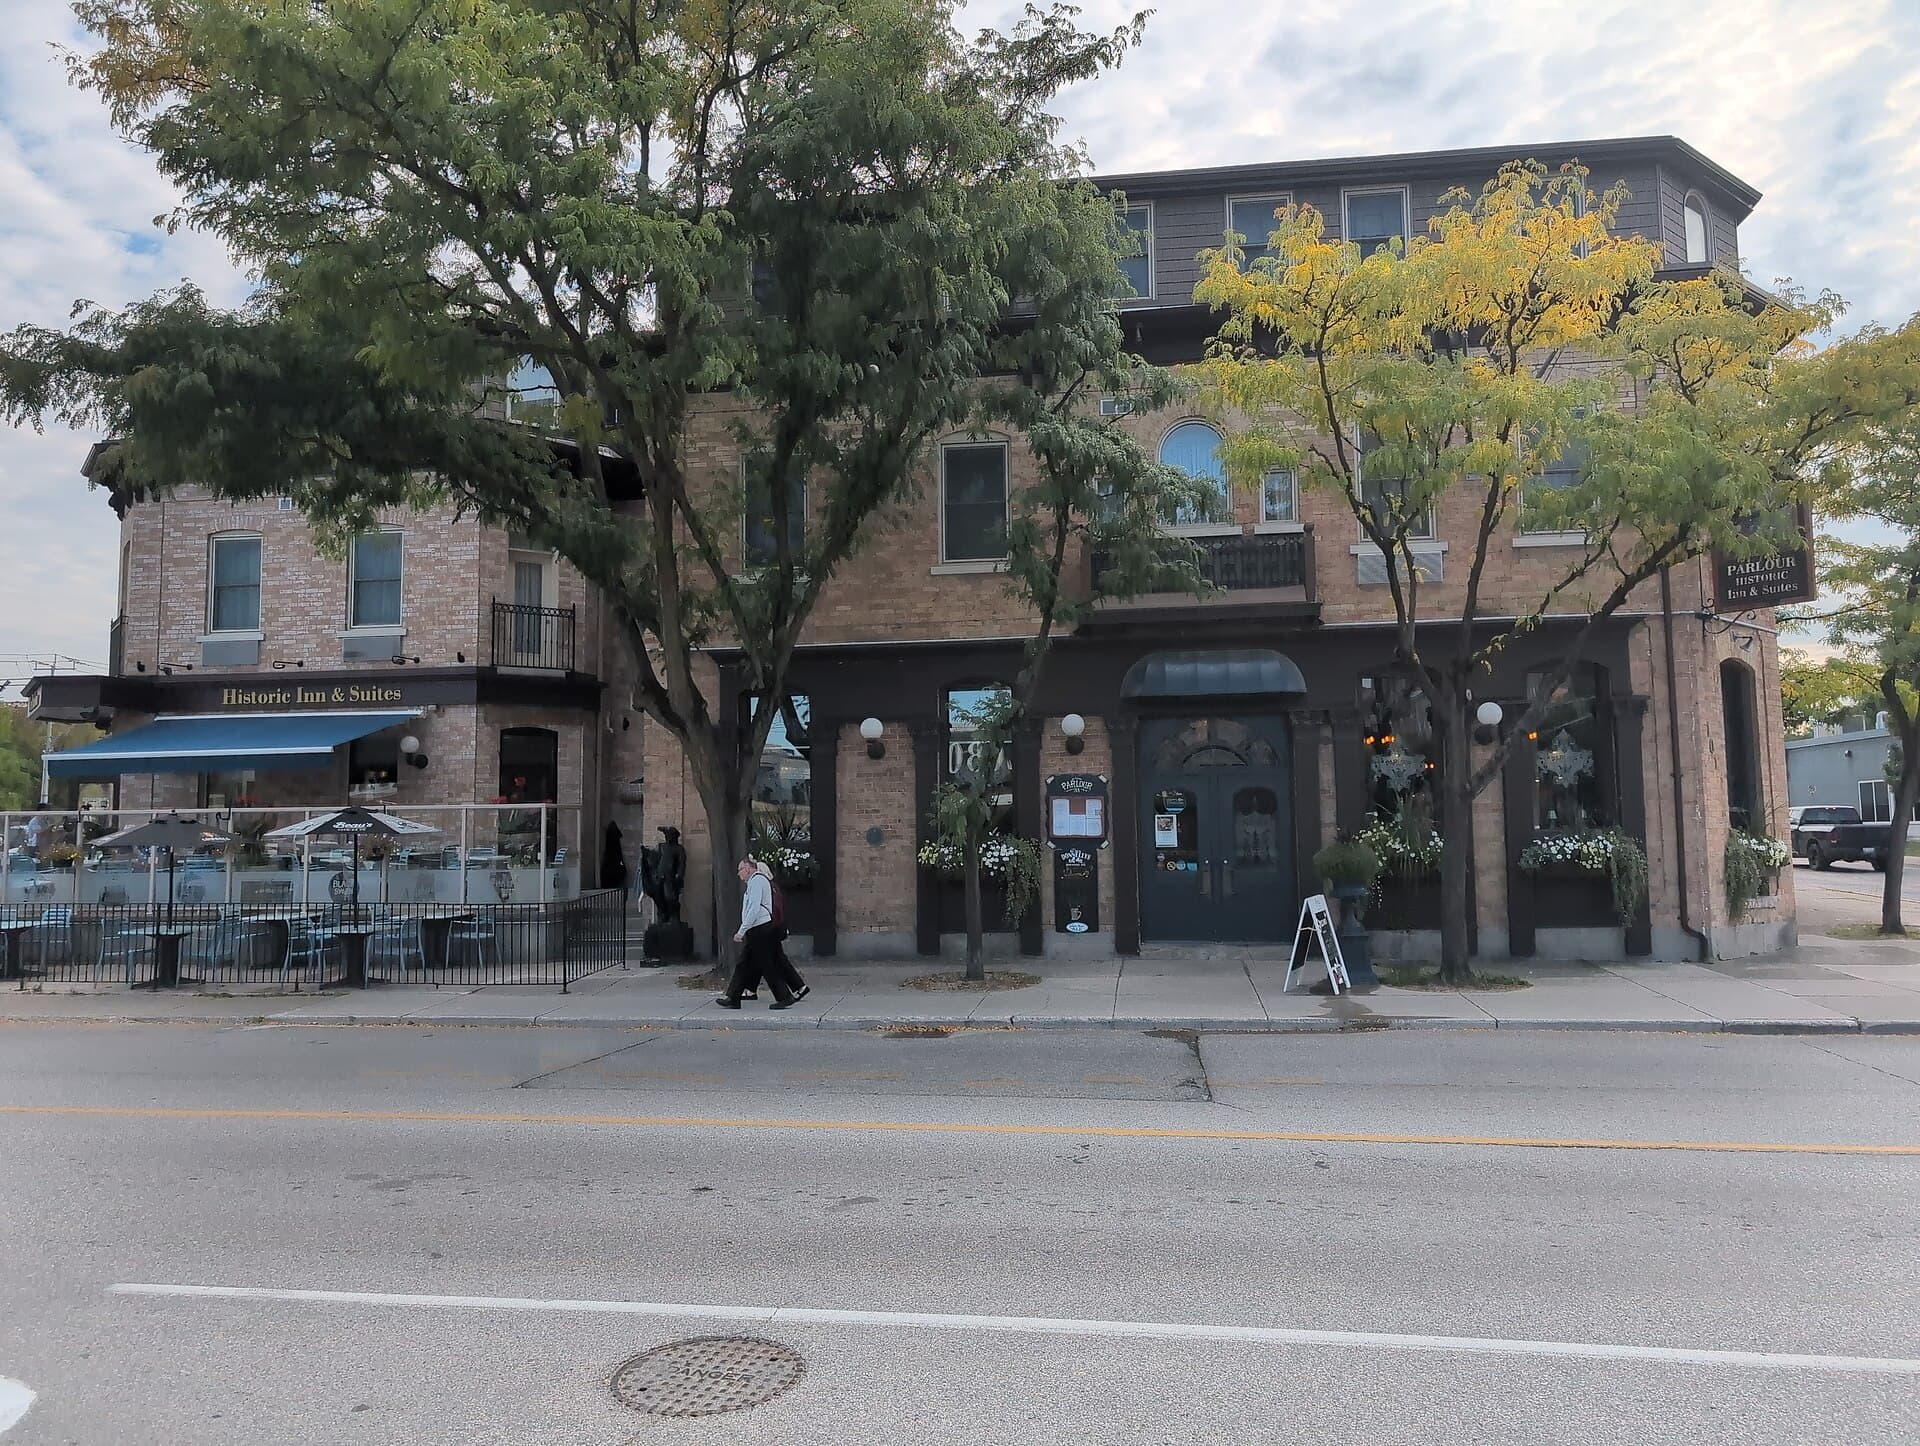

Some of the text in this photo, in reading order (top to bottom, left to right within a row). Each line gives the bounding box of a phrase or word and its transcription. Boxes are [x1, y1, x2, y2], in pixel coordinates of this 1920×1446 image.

[1727, 556, 1796, 576] PARLOUR
[1736, 570, 1789, 586] HISTORIC
[1727, 582, 1799, 600] Inn & Suites
[222, 685, 402, 705] Historic Inn & Suites
[668, 1364, 755, 1382] DANGER
